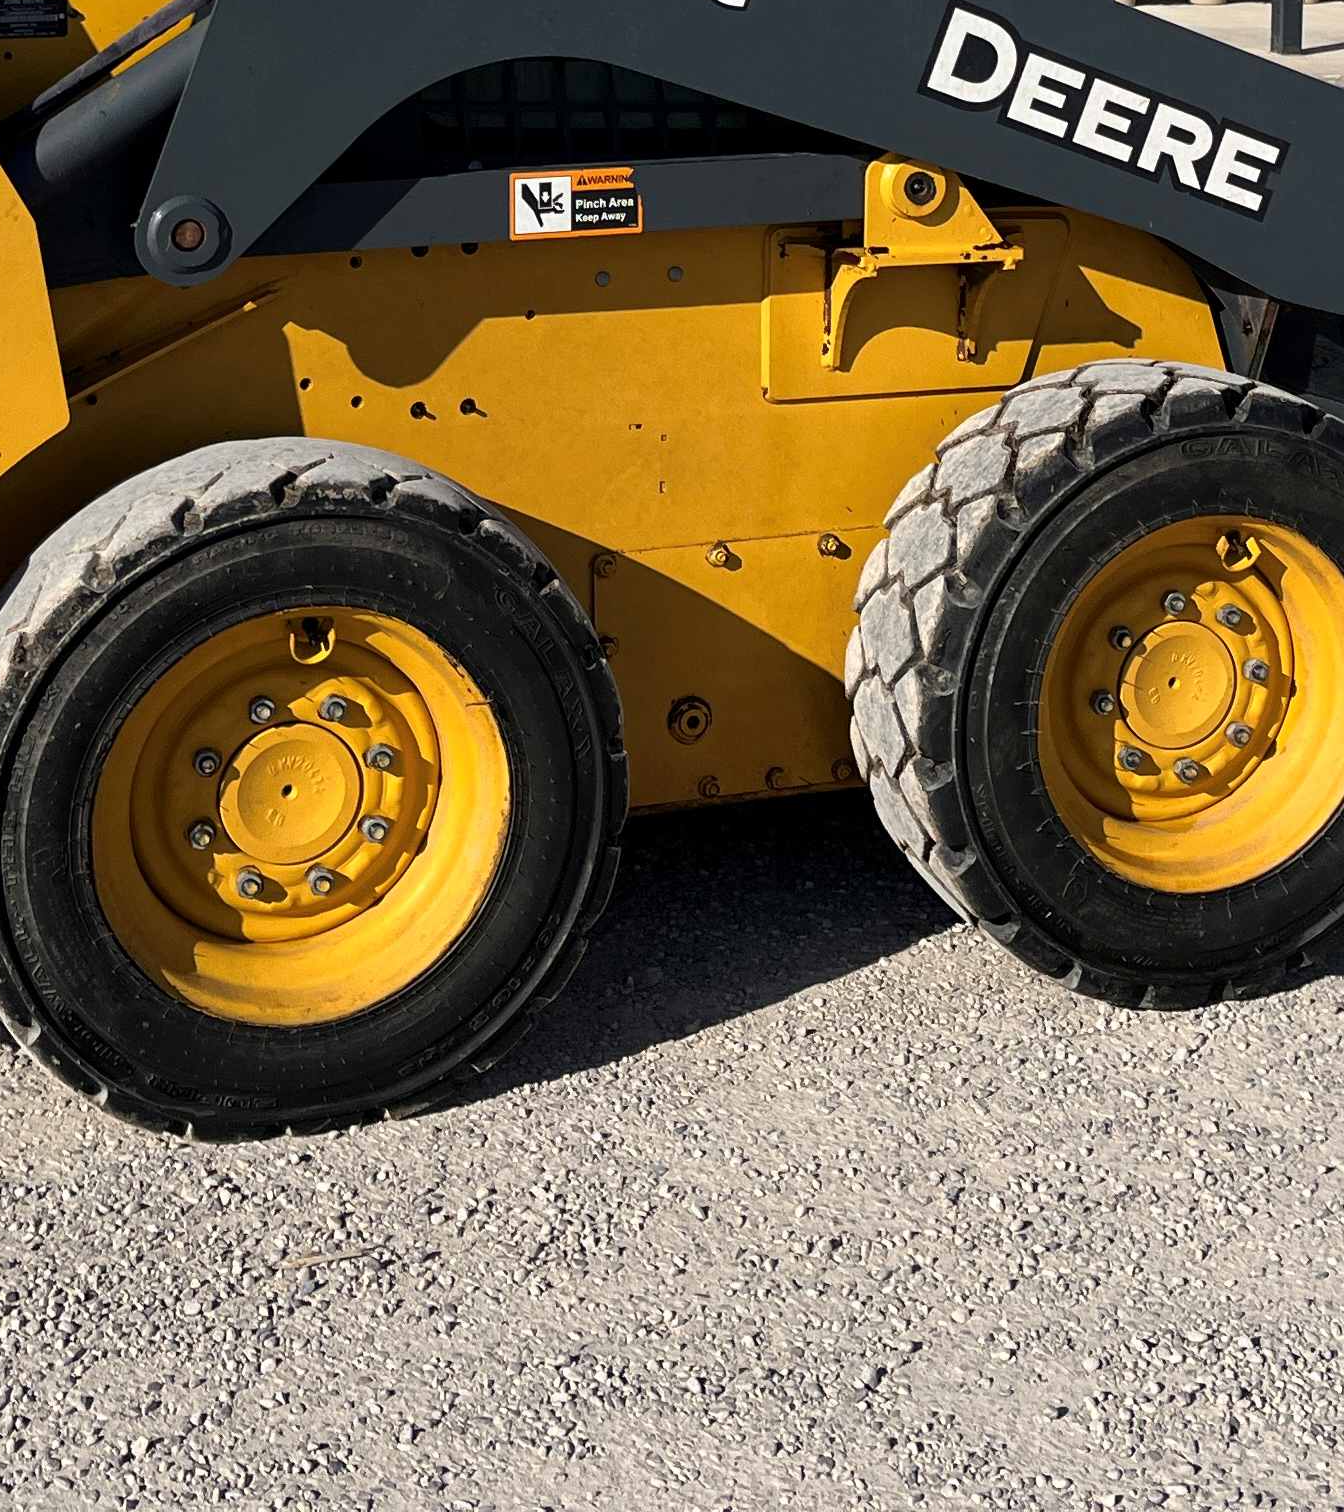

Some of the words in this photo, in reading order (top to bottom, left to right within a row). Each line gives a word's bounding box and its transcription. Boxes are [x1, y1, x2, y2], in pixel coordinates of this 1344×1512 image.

[925, 5, 1282, 213] DEERE
[587, 175, 633, 186] WARNIN
[575, 199, 606, 210] Pinch
[609, 197, 634, 208] Area
[575, 212, 599, 224] Keep
[601, 211, 626, 223] Away
